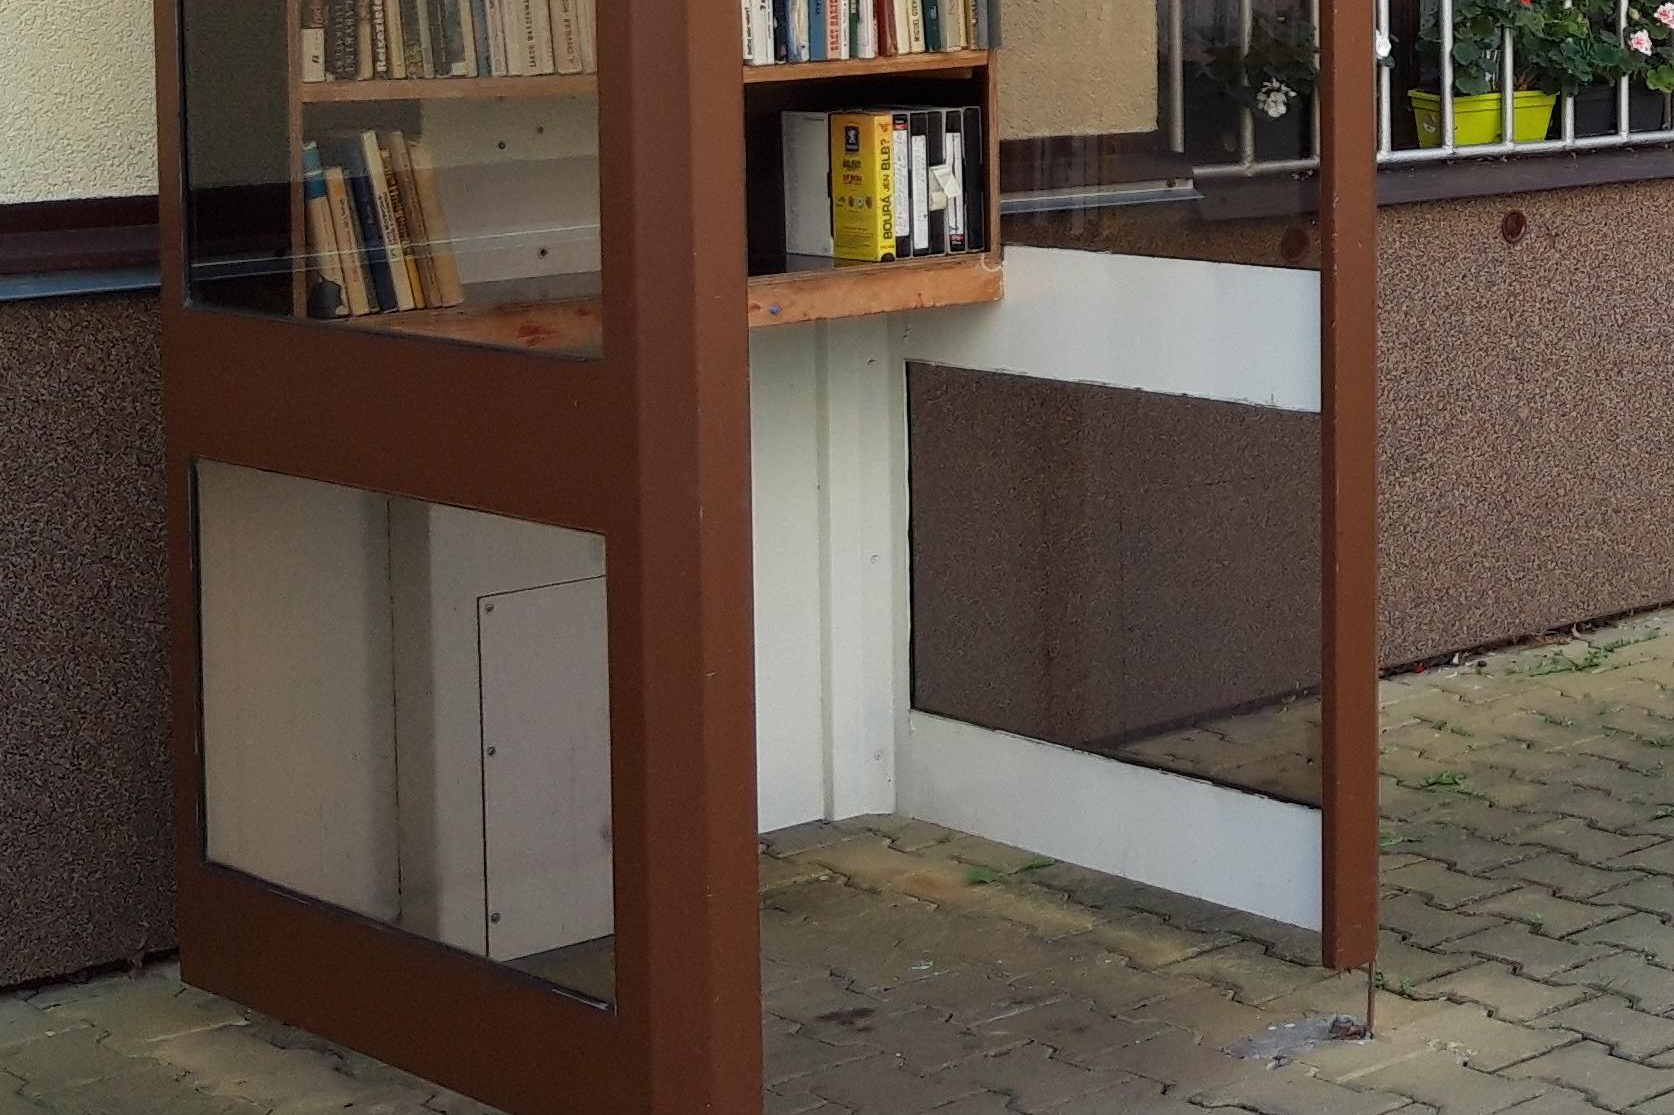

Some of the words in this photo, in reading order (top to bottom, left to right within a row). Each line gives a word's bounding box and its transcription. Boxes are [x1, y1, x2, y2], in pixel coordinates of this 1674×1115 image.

[880, 138, 891, 171] BLB?
[882, 174, 890, 191] JEN
[881, 195, 893, 240] BOURÁ
